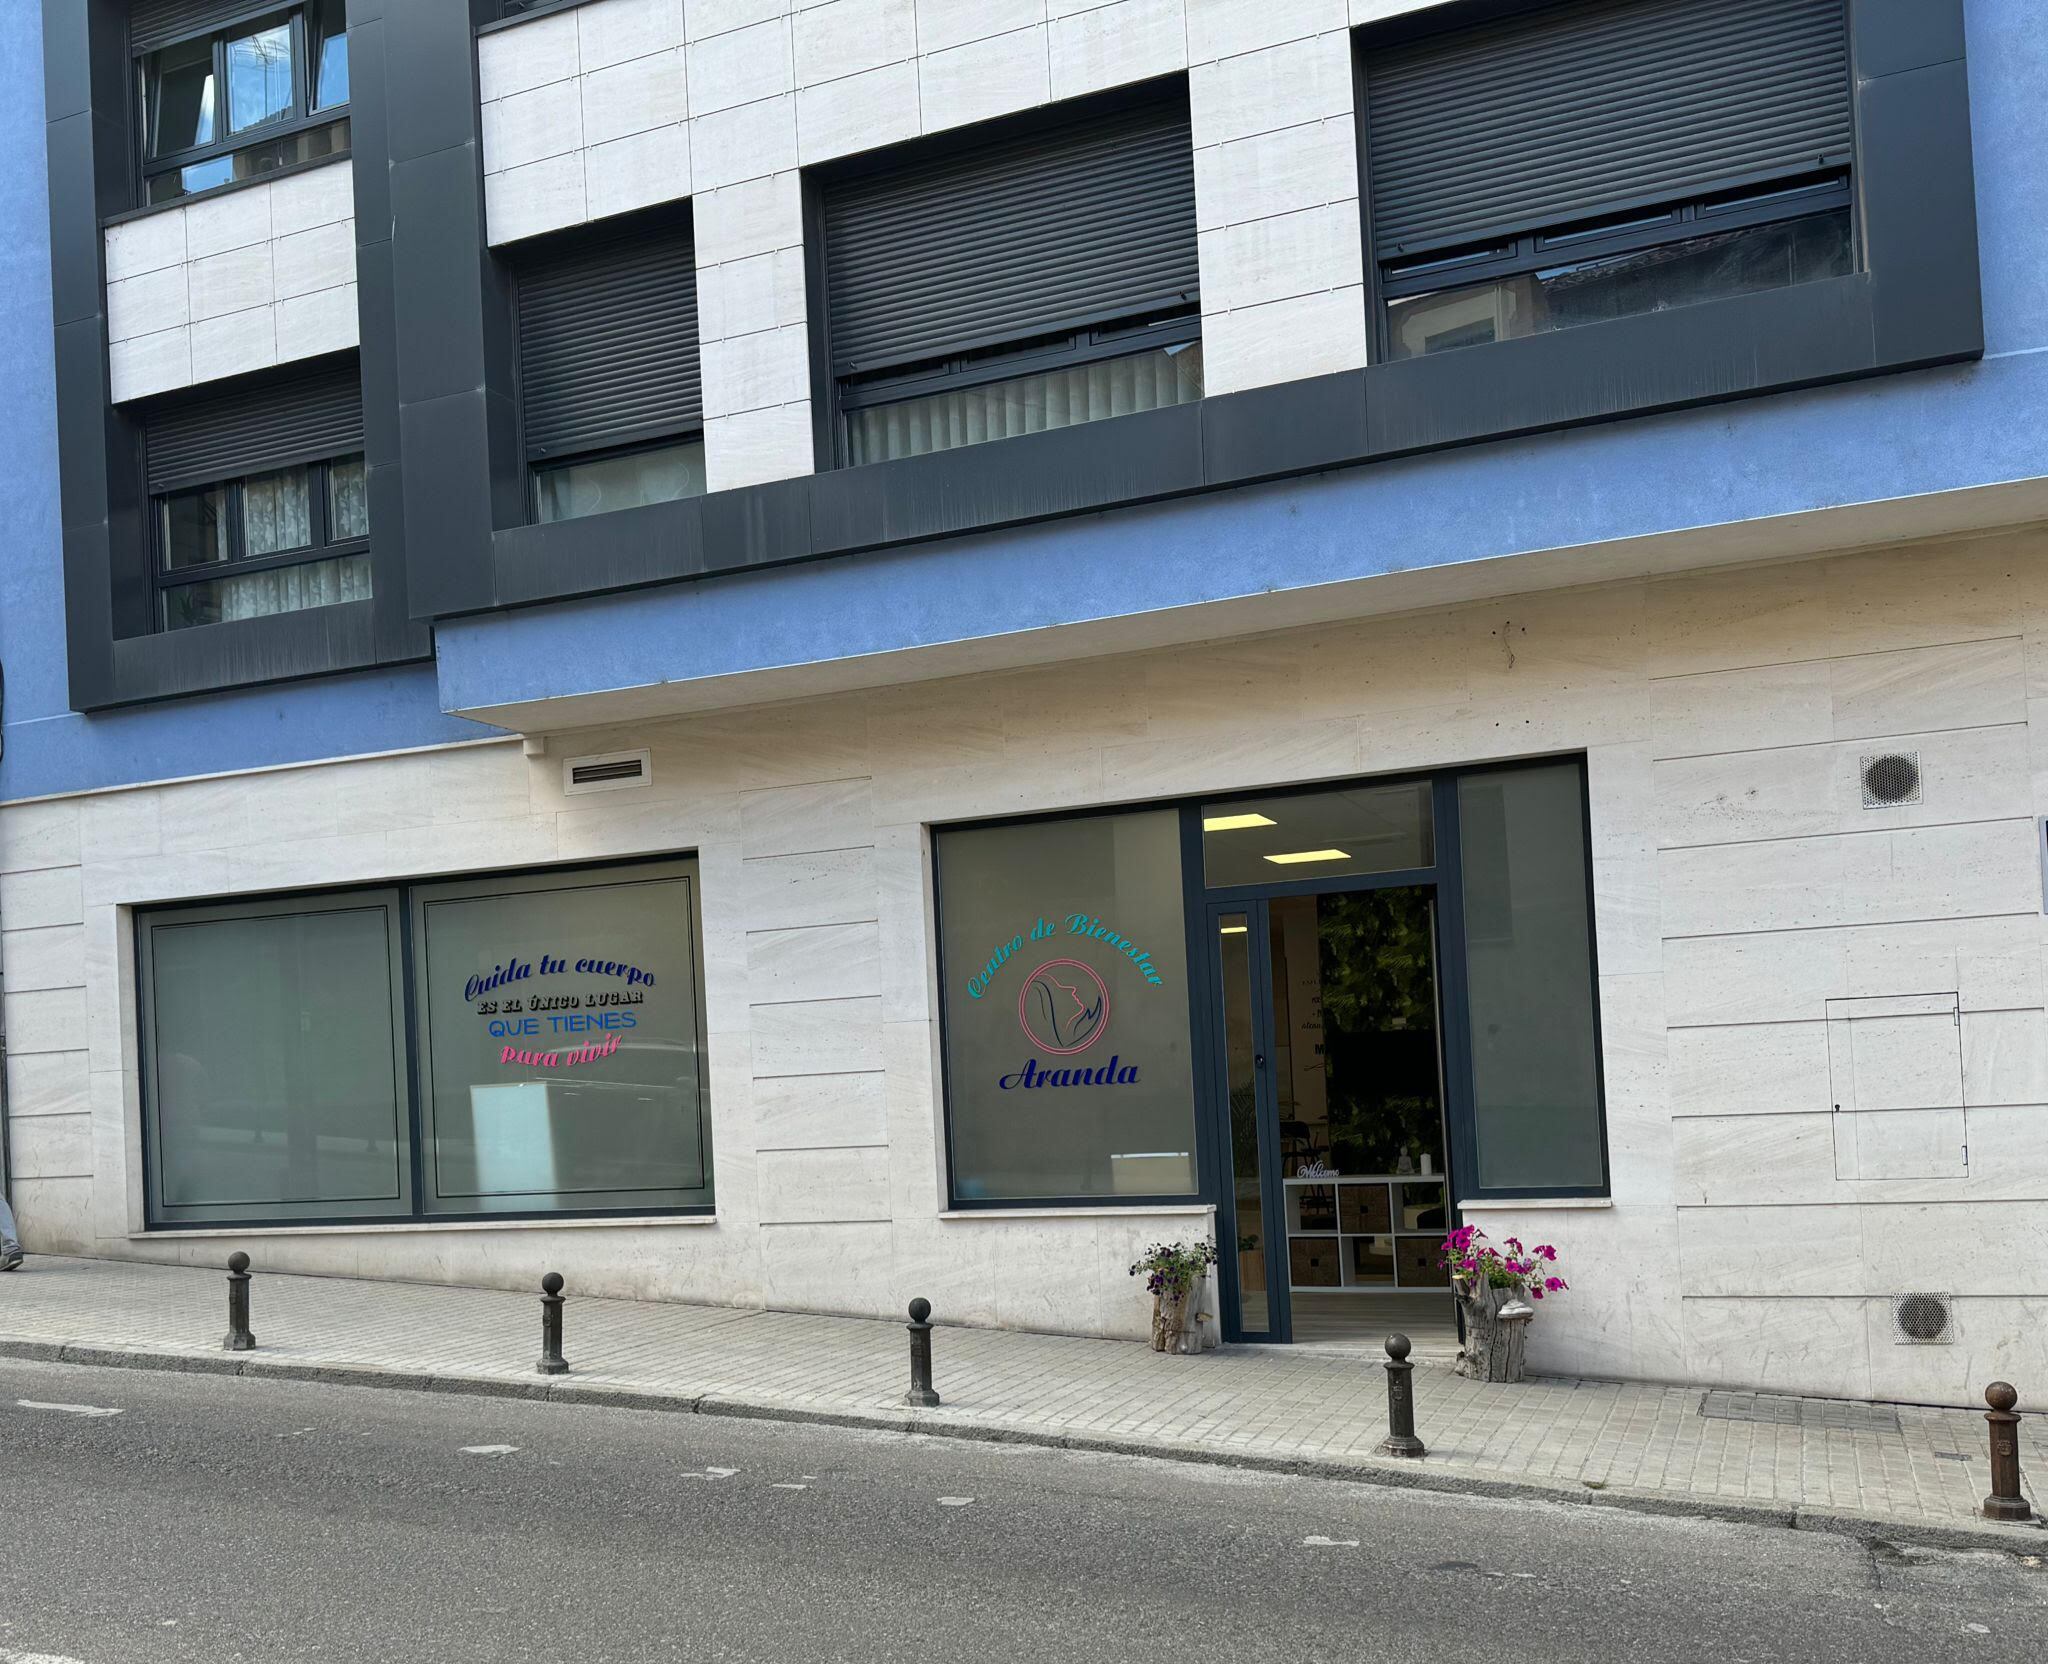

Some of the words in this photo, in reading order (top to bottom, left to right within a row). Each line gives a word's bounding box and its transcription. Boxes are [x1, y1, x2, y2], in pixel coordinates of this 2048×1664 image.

[967, 935, 1024, 999] Centro
[1030, 917, 1057, 941] de
[1064, 912, 1164, 986] Bienestar
[464, 957, 533, 1002] Cuida
[539, 954, 568, 976] tu
[575, 957, 657, 987] cuerpo
[477, 1001, 498, 1015] ES
[502, 999, 523, 1013] EL
[528, 993, 580, 1012] ÚNICO
[585, 991, 643, 1008] LUGAR
[488, 1018, 540, 1038] QUE
[547, 1011, 638, 1034] TIENES
[566, 1032, 623, 1067] vivir
[999, 1055, 1141, 1090] Aranda
